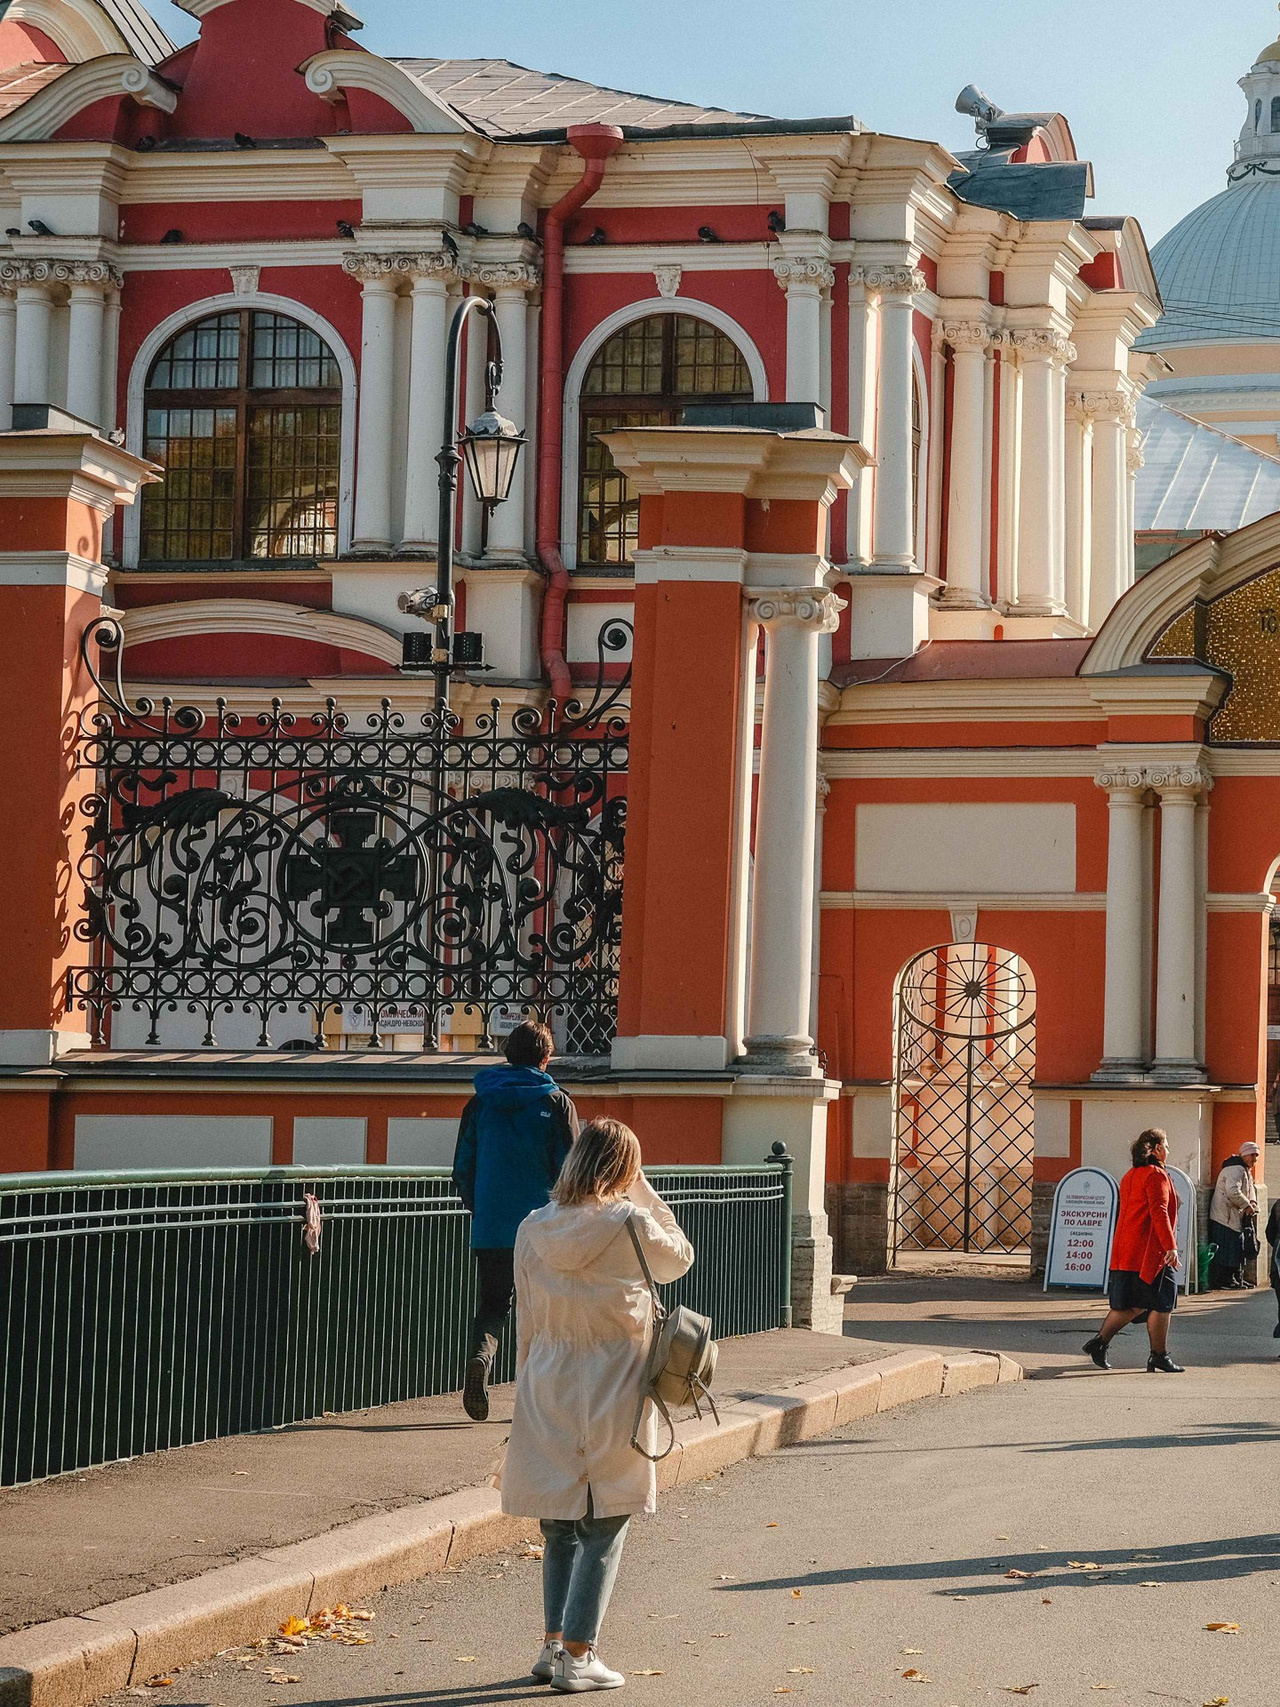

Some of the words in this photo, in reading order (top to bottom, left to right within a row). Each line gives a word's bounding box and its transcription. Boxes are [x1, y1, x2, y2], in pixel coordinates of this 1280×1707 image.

[1061, 1210, 1107, 1218] ЭКСКУРСИИ
[1067, 1239, 1094, 1247] 12:00
[1066, 1251, 1093, 1259] 14:00
[1065, 1263, 1091, 1271] 16:00
